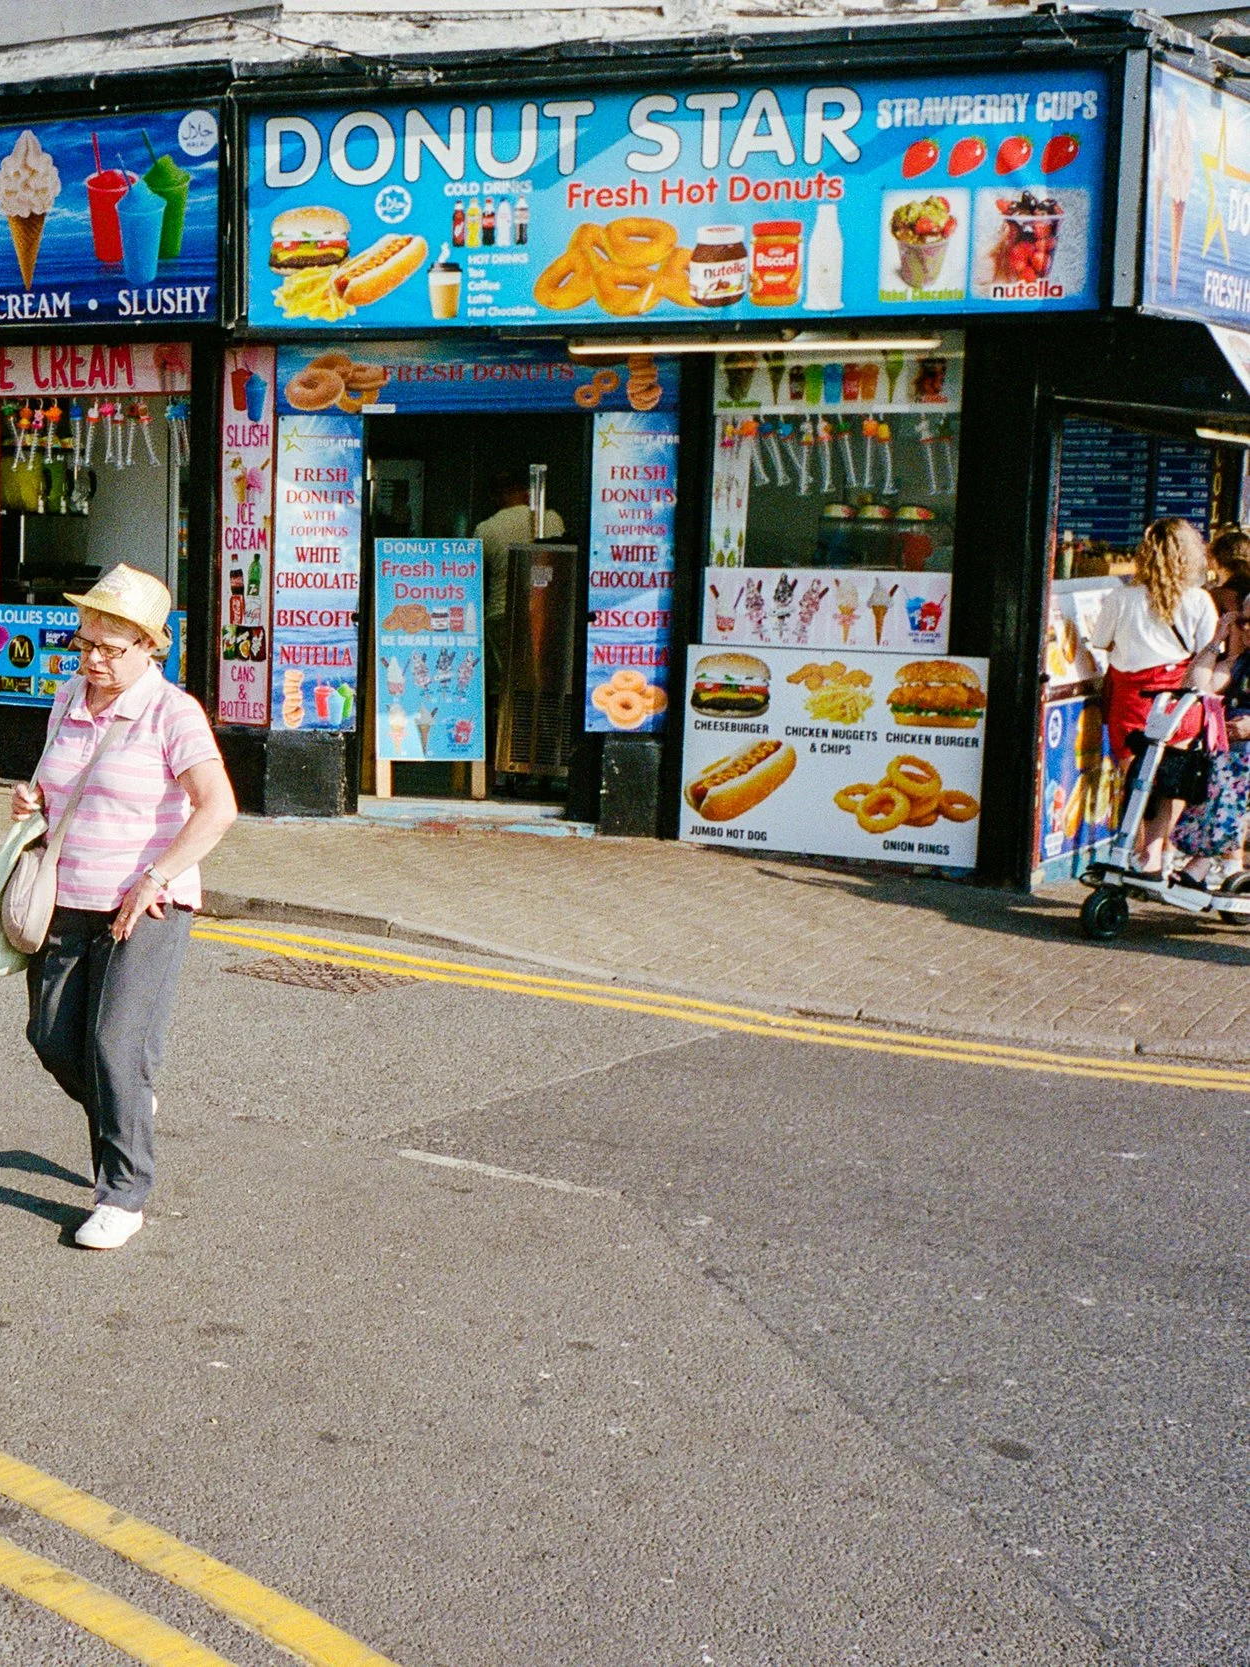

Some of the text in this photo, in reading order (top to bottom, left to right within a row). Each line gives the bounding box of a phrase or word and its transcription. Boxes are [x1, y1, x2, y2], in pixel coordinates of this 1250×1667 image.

[876, 90, 1098, 129] STRAWBERRY CUPS
[264, 86, 863, 189] DONUT STAR
[444, 179, 533, 196] COLD DRINKS
[567, 172, 843, 208] Fresh Hot Donuts
[993, 280, 1063, 299] nutella
[1205, 269, 1242, 311] FRESH
[118, 286, 210, 316] SLUSHY
[32, 344, 134, 389] CREAM
[383, 361, 576, 383] FRESH DONUTS
[226, 424, 269, 447] SLUSH
[294, 468, 347, 482] FRESH
[610, 466, 667, 481] FRESH
[286, 490, 355, 505] DONUTS
[601, 488, 676, 503] DONUTS
[237, 502, 255, 526] ICE
[302, 510, 336, 521] WITH
[618, 509, 653, 520] WITH
[225, 528, 268, 551] CREAM
[289, 525, 348, 537] TOPPINGS
[604, 525, 667, 537] TOPPINGS
[295, 546, 341, 564] WHITE
[383, 542, 476, 555] DONUT STAR
[611, 545, 658, 562] WHITE
[381, 560, 477, 578] Fresh Hot
[276, 572, 357, 590] CHOCOLATE
[590, 571, 676, 588] CHOCOLATE
[394, 583, 464, 600] Donuts
[0, 609, 43, 625] LOLLIES
[46, 611, 80, 626] SOLD
[591, 610, 674, 628] BISCOFF
[279, 646, 354, 666] NUTELLA
[593, 645, 671, 666] NUTELLA
[231, 665, 255, 682] CANS
[238, 685, 247, 699] &
[220, 701, 265, 720] BOTTLES
[694, 720, 769, 735] CHEESEBURGER
[785, 726, 878, 742] CHICKEN NUGGETS
[886, 732, 979, 748] CHICKEN BURGER
[810, 743, 851, 755] & CHIPS
[690, 826, 767, 842] JUMBO HOT DOG
[883, 840, 949, 855] ONION RINGS
